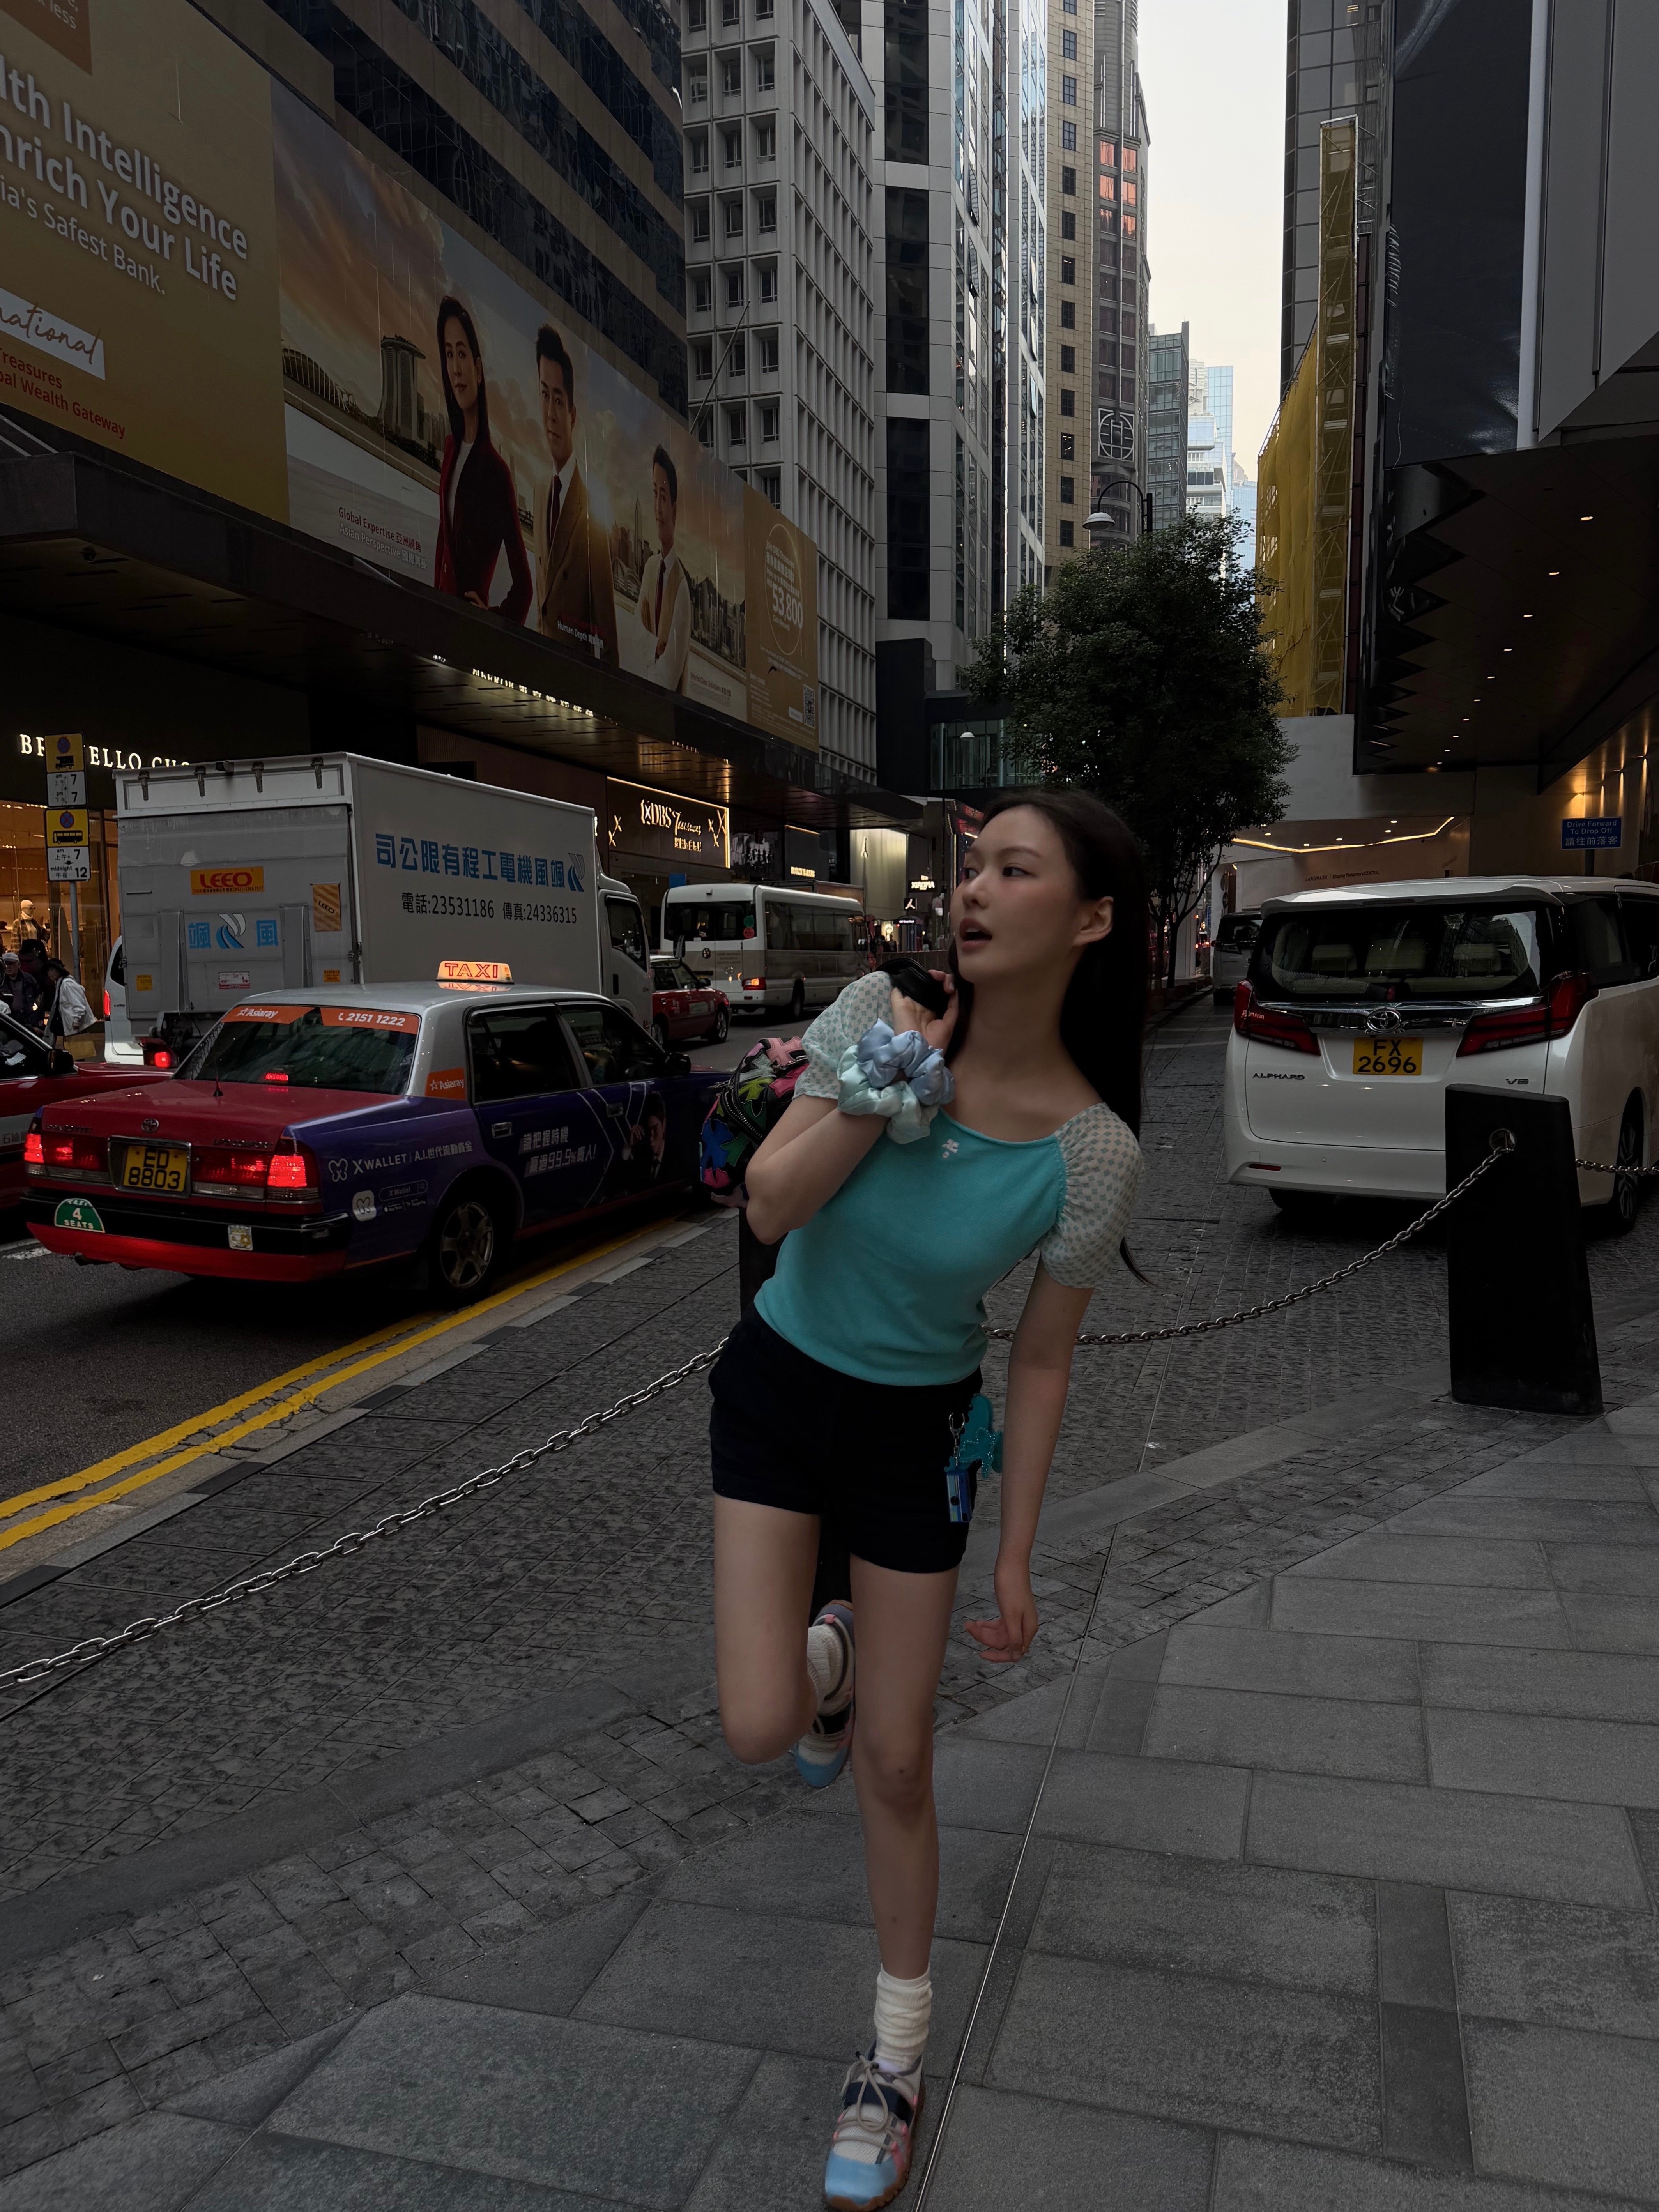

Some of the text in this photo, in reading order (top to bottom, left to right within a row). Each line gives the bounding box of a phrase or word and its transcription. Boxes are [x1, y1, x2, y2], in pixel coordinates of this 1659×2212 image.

[64, 102, 247, 259] Intelligence
[97, 179, 175, 260] Your
[185, 236, 237, 301] Life
[44, 203, 108, 261] Safest
[113, 244, 166, 295] Bank.
[21, 377, 69, 411] Wealth
[73, 401, 125, 439] Gateway
[339, 507, 361, 526] Global
[364, 518, 394, 541] Expertise
[340, 523, 359, 541] Asian
[361, 532, 400, 559] Perspective
[772, 583, 803, 629] 53,800
[557, 620, 574, 636] Human
[71, 774, 77, 785] 7
[72, 792, 78, 803] 7
[651, 802, 672, 828] DBS
[1565, 836, 1618, 847] 請往前落客
[74, 849, 80, 860] 7
[75, 867, 87, 878] 12
[200, 872, 253, 888] LEEO
[402, 892, 577, 923] 電話:23531186 傳真:24336315
[444, 963, 498, 978] TAXI
[245, 1008, 278, 1018] Asiaray
[346, 1013, 406, 1026] 2151 1222
[1373, 1039, 1402, 1056] FX
[1358, 1056, 1417, 1073] 2696
[439, 1079, 464, 1090] Asiaray
[144, 1149, 169, 1169] ED
[129, 1167, 180, 1190] 8803
[72, 1208, 82, 1220] 4
[64, 1219, 94, 1229] SEATS
